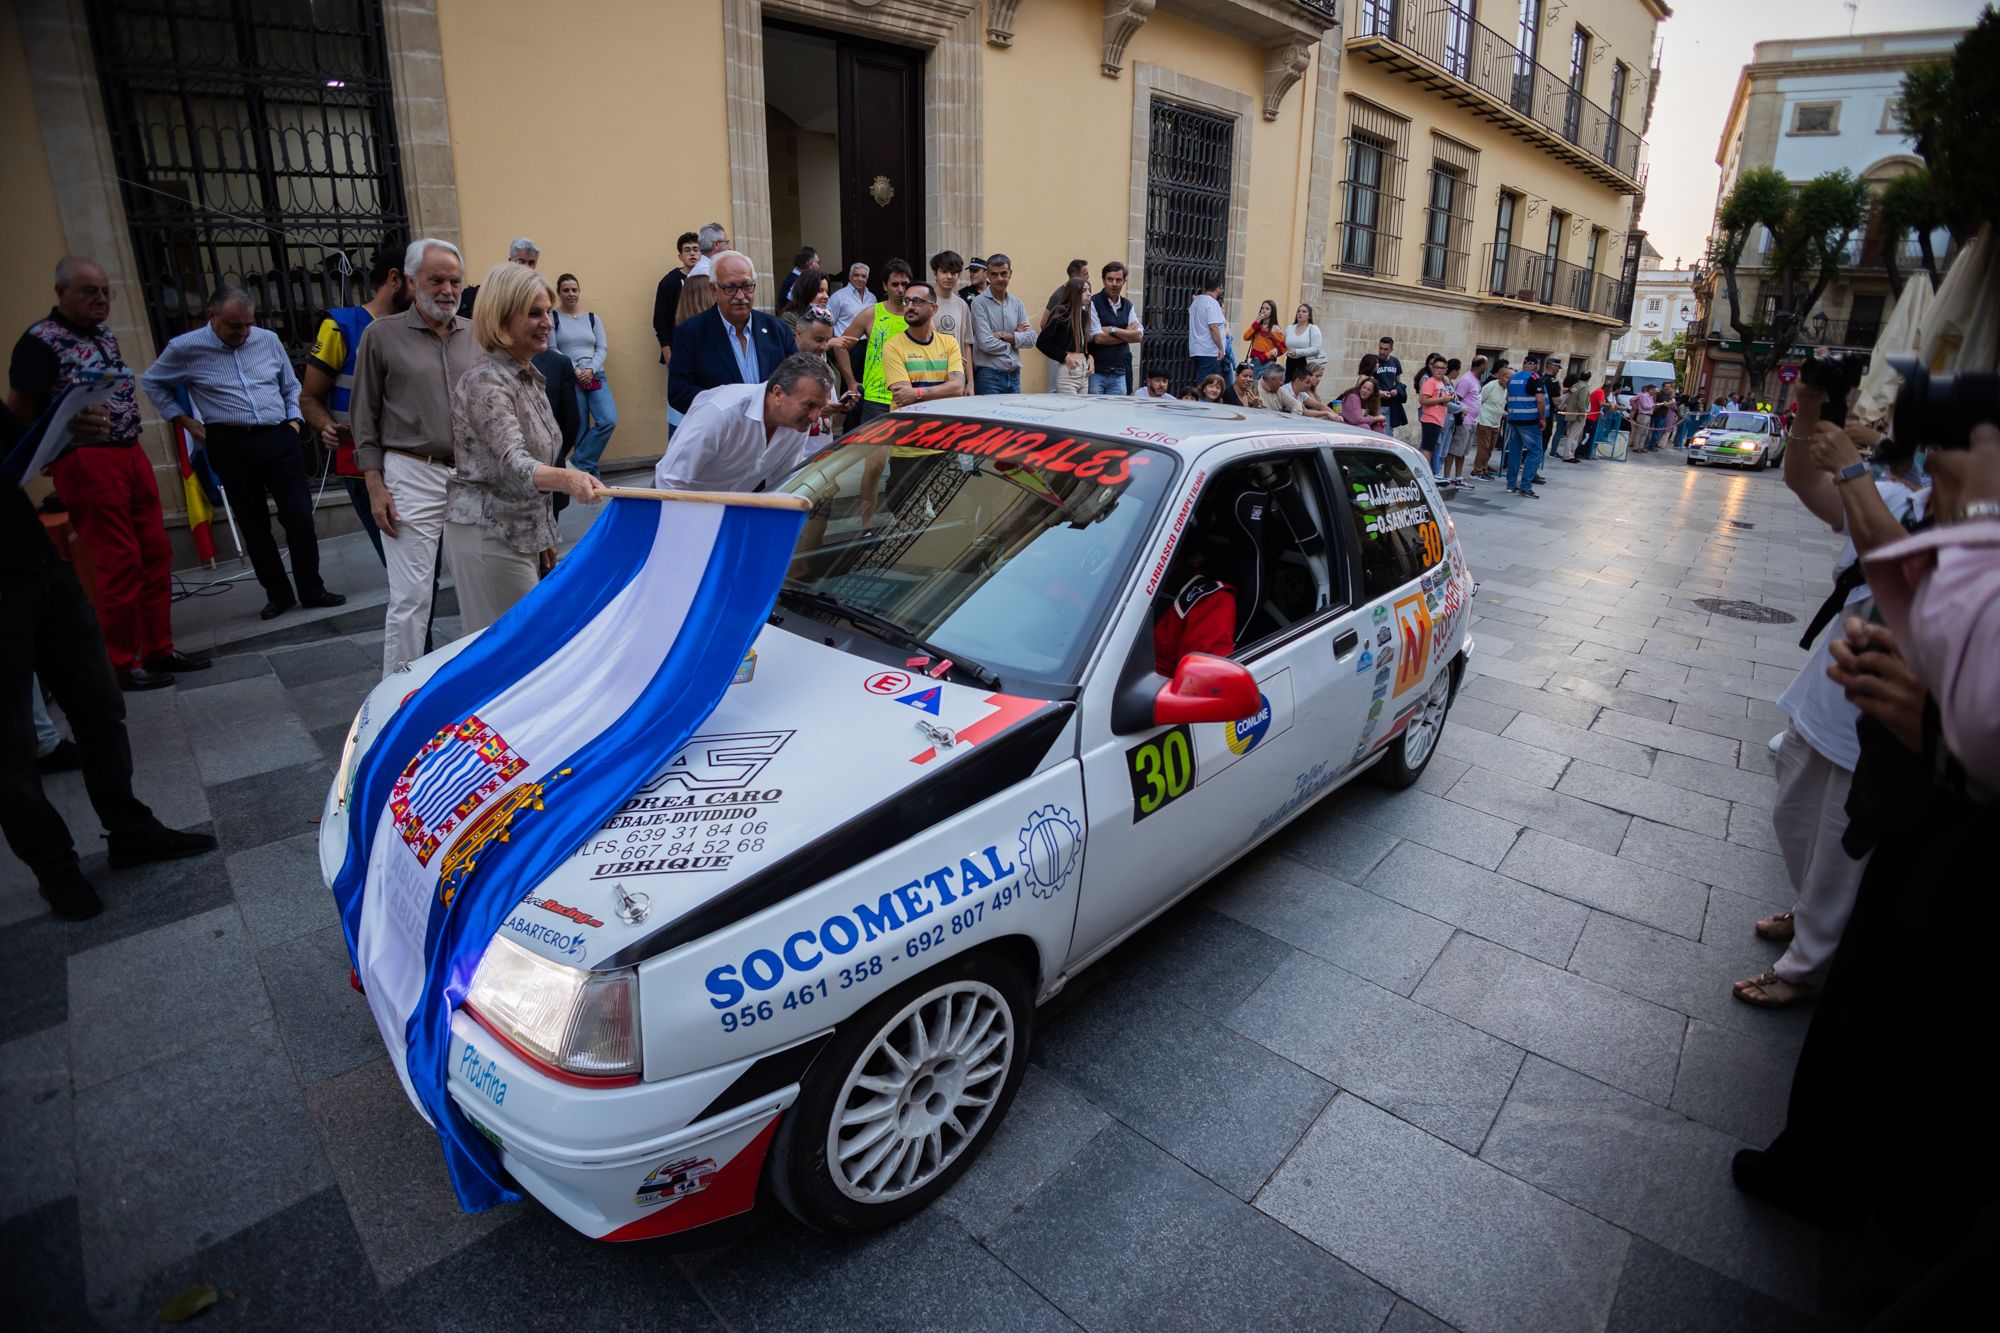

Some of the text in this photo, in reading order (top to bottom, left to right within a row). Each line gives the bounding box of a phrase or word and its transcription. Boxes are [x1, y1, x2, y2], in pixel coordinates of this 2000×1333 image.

[1119, 426, 1180, 447] Sofia
[840, 419, 1151, 486] LOS BARANDALES
[1419, 520, 1442, 568] 30
[1145, 533, 1178, 597] CARRASCO
[872, 675, 903, 691] E
[1237, 708, 1269, 735] COMLINE
[1135, 730, 1191, 814] 30
[618, 788, 783, 811] DREA CARO
[600, 806, 758, 830] EBAJE-DIVIDIDO
[626, 821, 768, 844] 639 31 84 06
[620, 838, 766, 861] 667 84 52 68
[594, 855, 735, 876] UBRIQUE
[705, 845, 1015, 1010] SOCOMETAL
[720, 1000, 774, 1033] 956
[782, 978, 829, 1011] 461
[839, 955, 883, 989] 358
[905, 924, 946, 958] 692
[951, 902, 986, 935] 807
[992, 880, 1022, 911] 491
[460, 1043, 507, 1106] Pitufina
